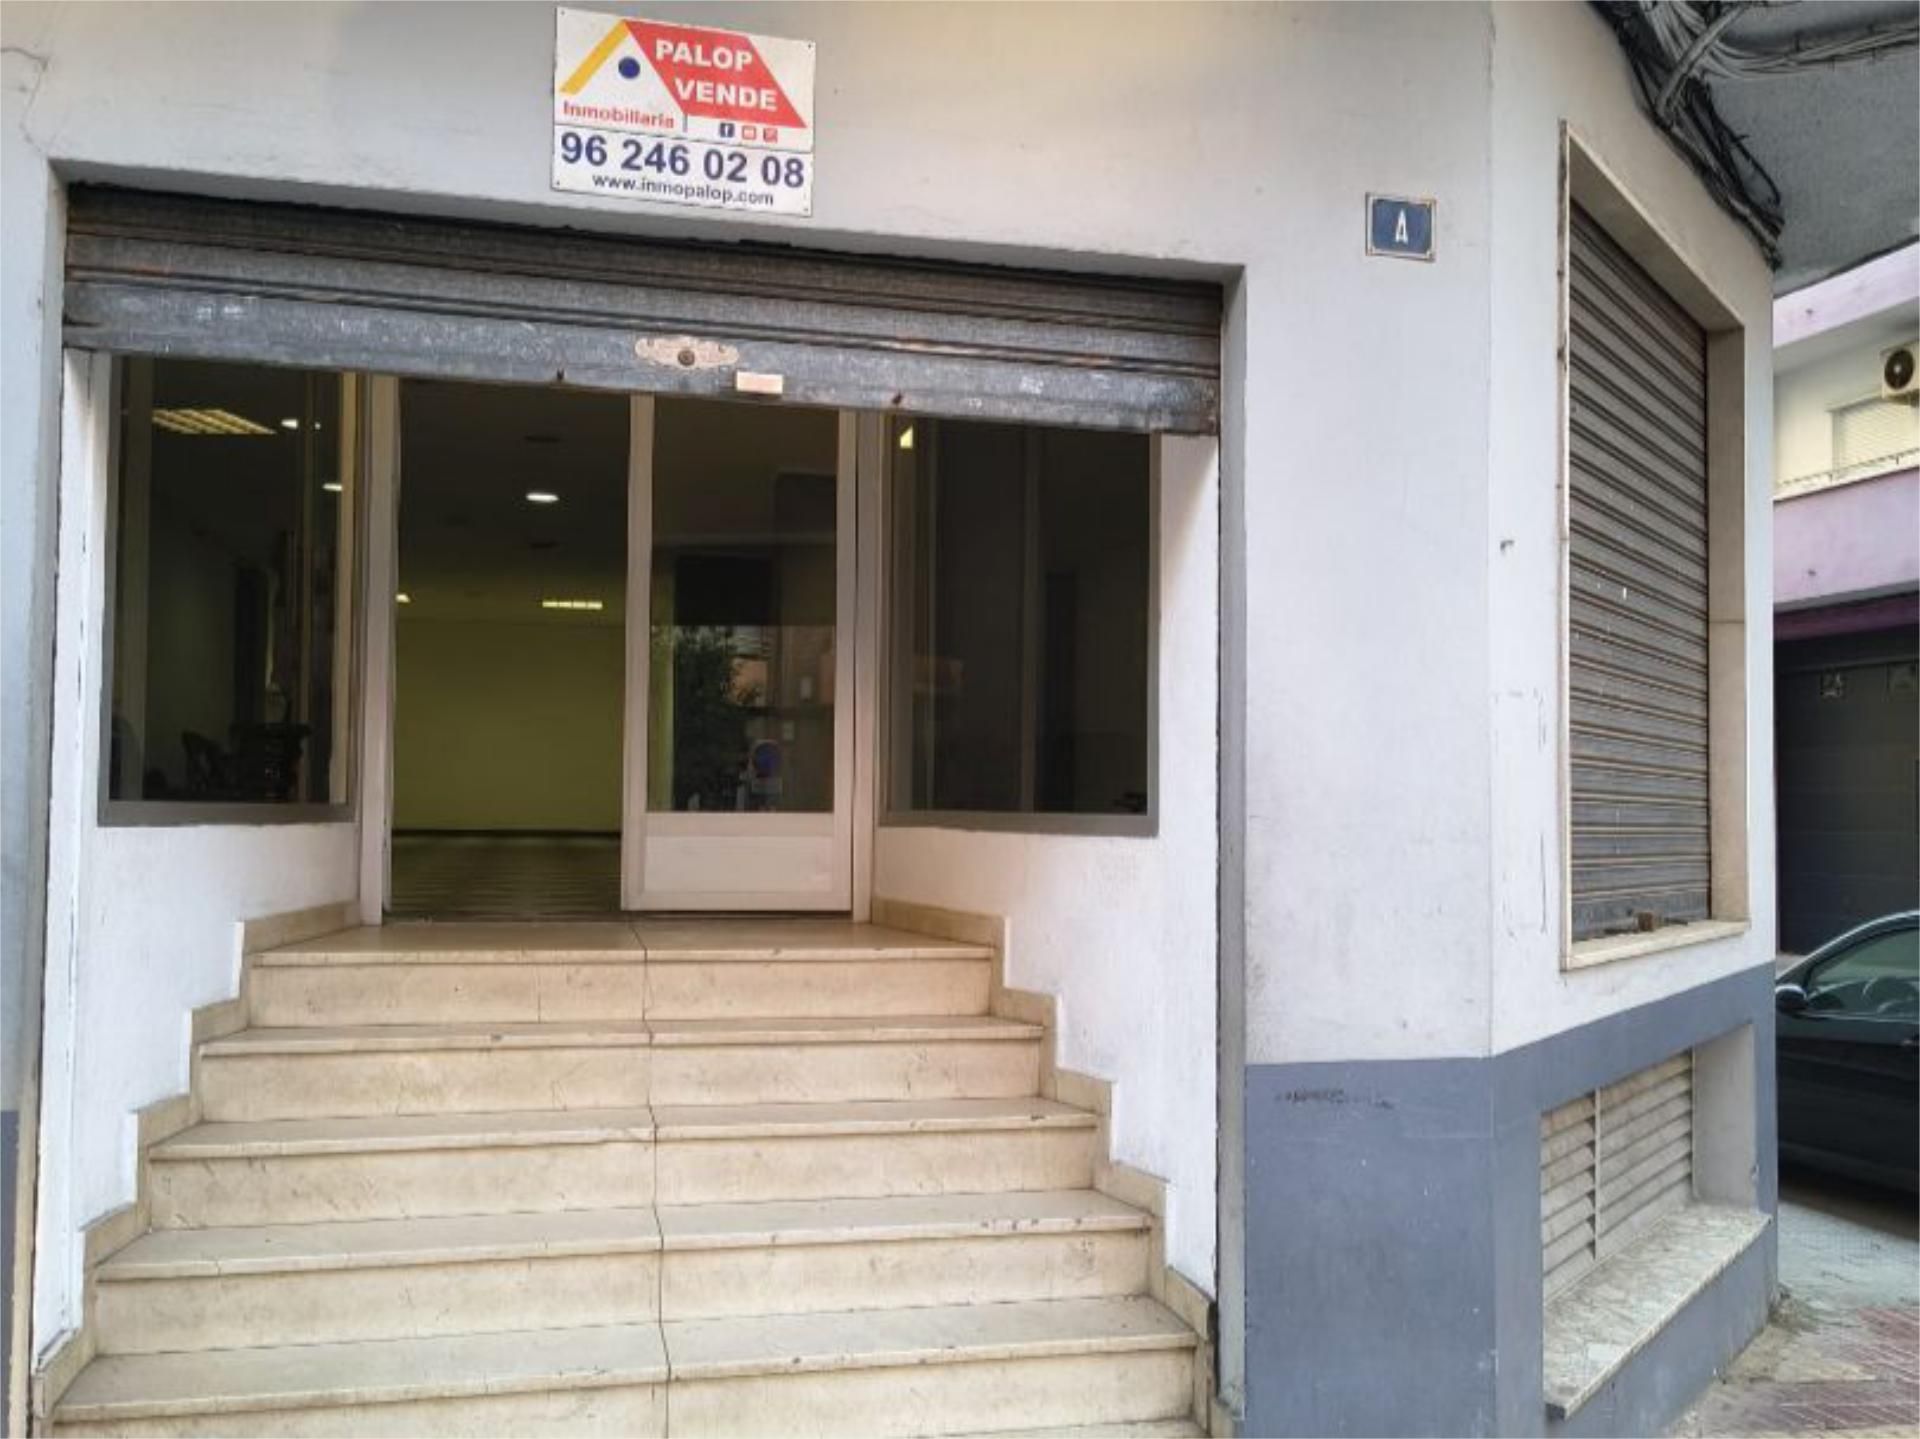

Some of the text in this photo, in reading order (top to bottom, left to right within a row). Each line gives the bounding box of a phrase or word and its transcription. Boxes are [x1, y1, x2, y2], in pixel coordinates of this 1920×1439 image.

[655, 39, 753, 71] PALOP
[675, 79, 778, 111] VENDE
[563, 101, 675, 128] Inmobiliaria
[561, 132, 805, 188] 96 246 02 08
[592, 175, 774, 206] www.inmopalop.com
[1395, 208, 1408, 245] A
